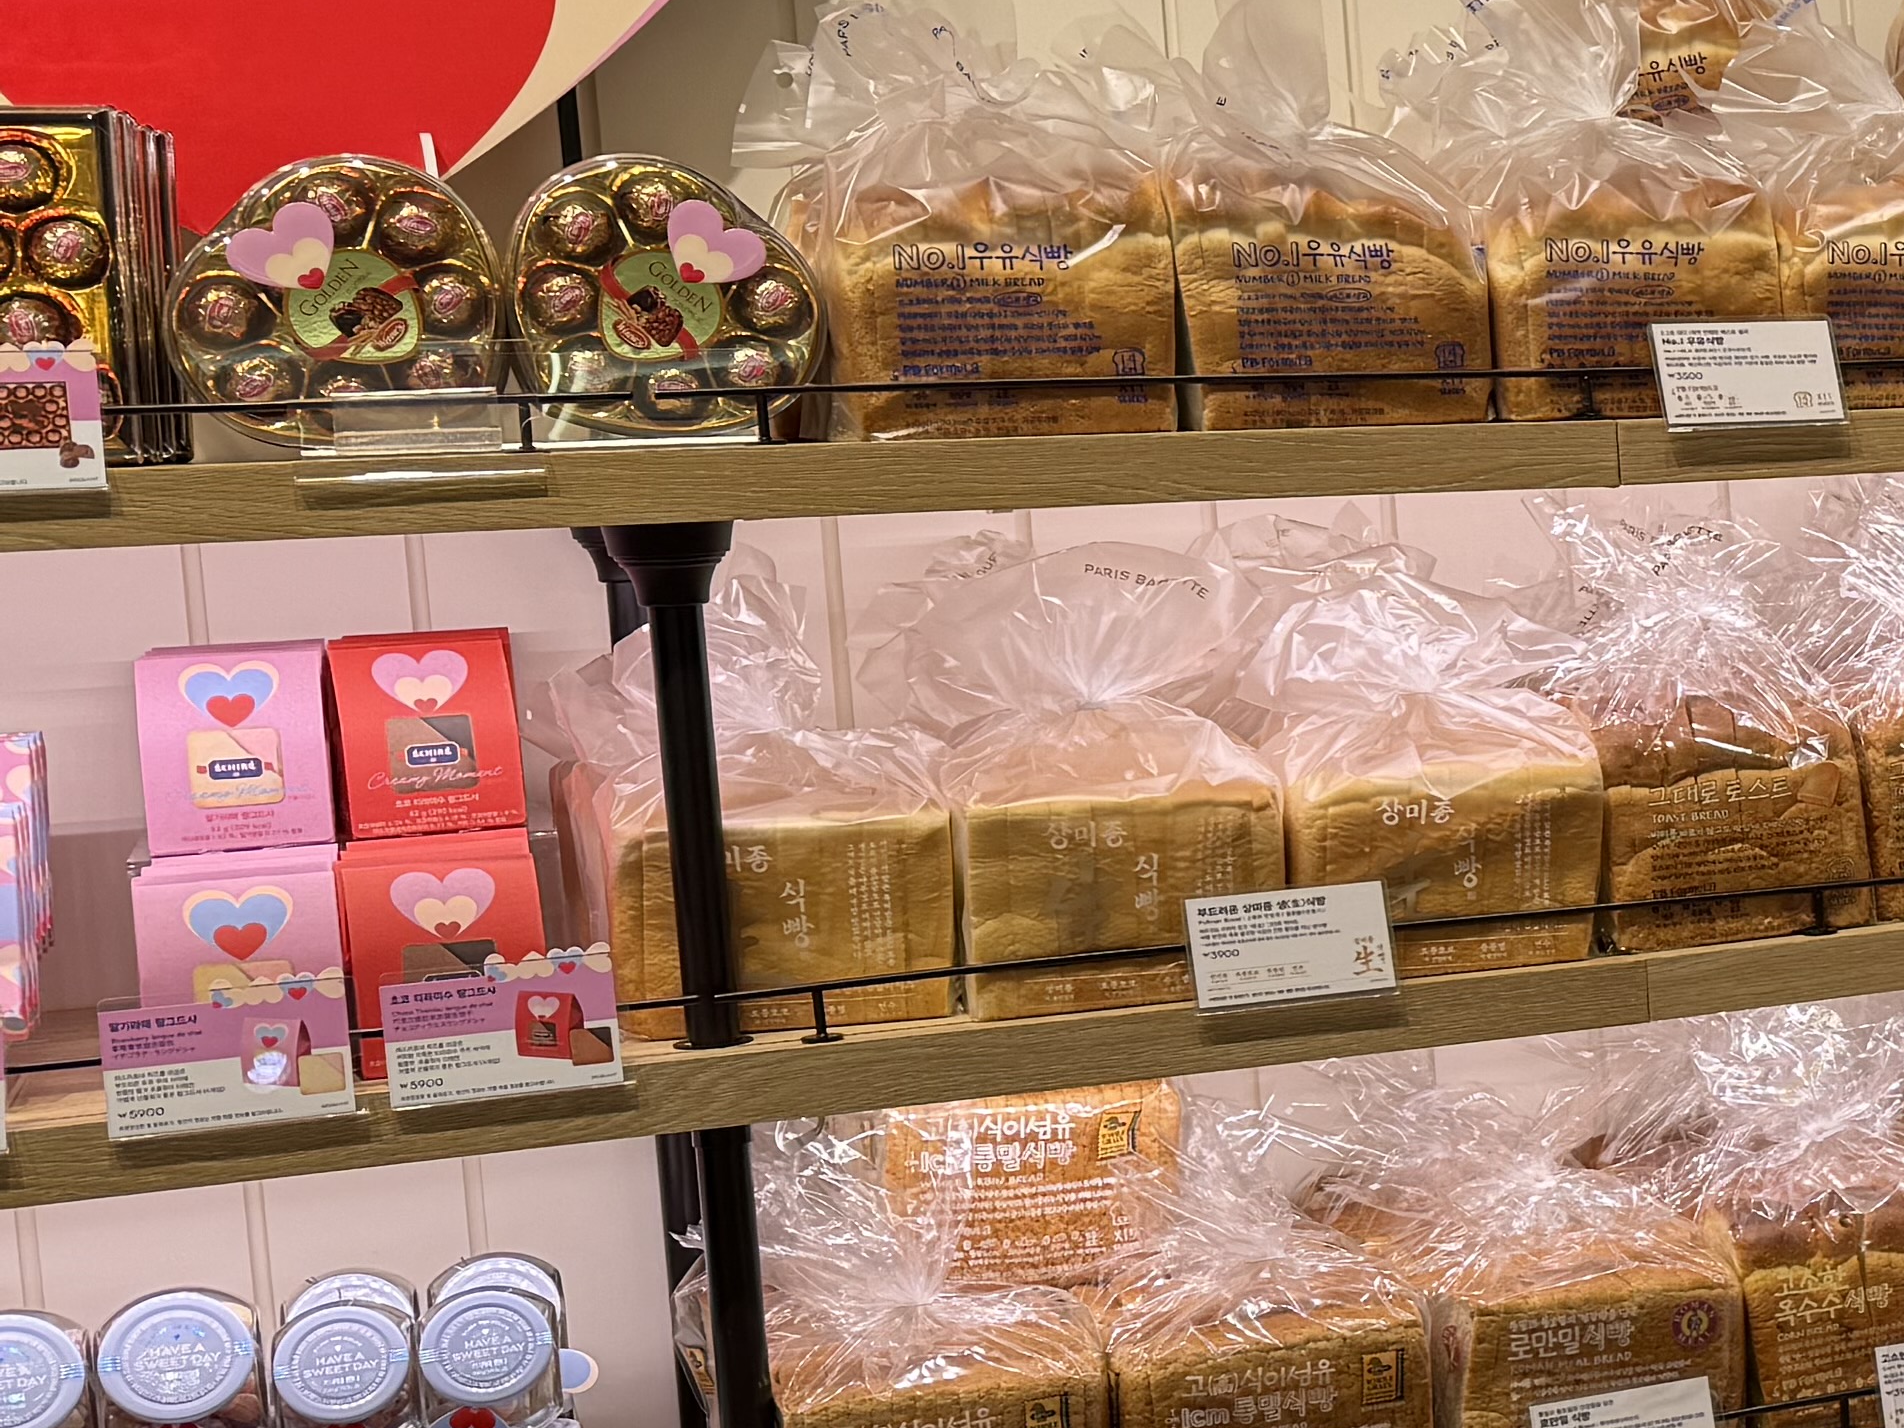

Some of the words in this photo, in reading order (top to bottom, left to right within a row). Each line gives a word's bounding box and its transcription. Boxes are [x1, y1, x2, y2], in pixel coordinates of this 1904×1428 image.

[297, 258, 359, 318] GOLDEN
[647, 259, 713, 314] GOLDEN
[1084, 563, 1131, 581] PARIS
[1374, 797, 1457, 828] 상미종
[1652, 811, 1686, 824] TOAST
[1690, 807, 1729, 821] BREAD
[1045, 819, 1128, 852] 상미종
[1197, 903, 1239, 917] 부드러운
[1353, 944, 1384, 976] 生
[1774, 1267, 1847, 1297] 고소한
[1774, 1284, 1893, 1324] 옥수수식빵
[150, 1346, 189, 1359] HAVE
[195, 1343, 205, 1353] A
[453, 1348, 496, 1362] SWEET
[497, 1342, 526, 1356] DAY
[464, 1338, 499, 1350] HAVE
[501, 1335, 513, 1346] A
[1507, 1322, 1636, 1363] 로만밀식빵
[133, 1355, 187, 1371] SWEET
[189, 1351, 221, 1366] DAY
[302, 1364, 347, 1379] SWEET
[348, 1359, 379, 1371] DAY
[316, 1354, 351, 1367] HAVE
[354, 1352, 364, 1362] A
[17, 1374, 47, 1388] DAY
